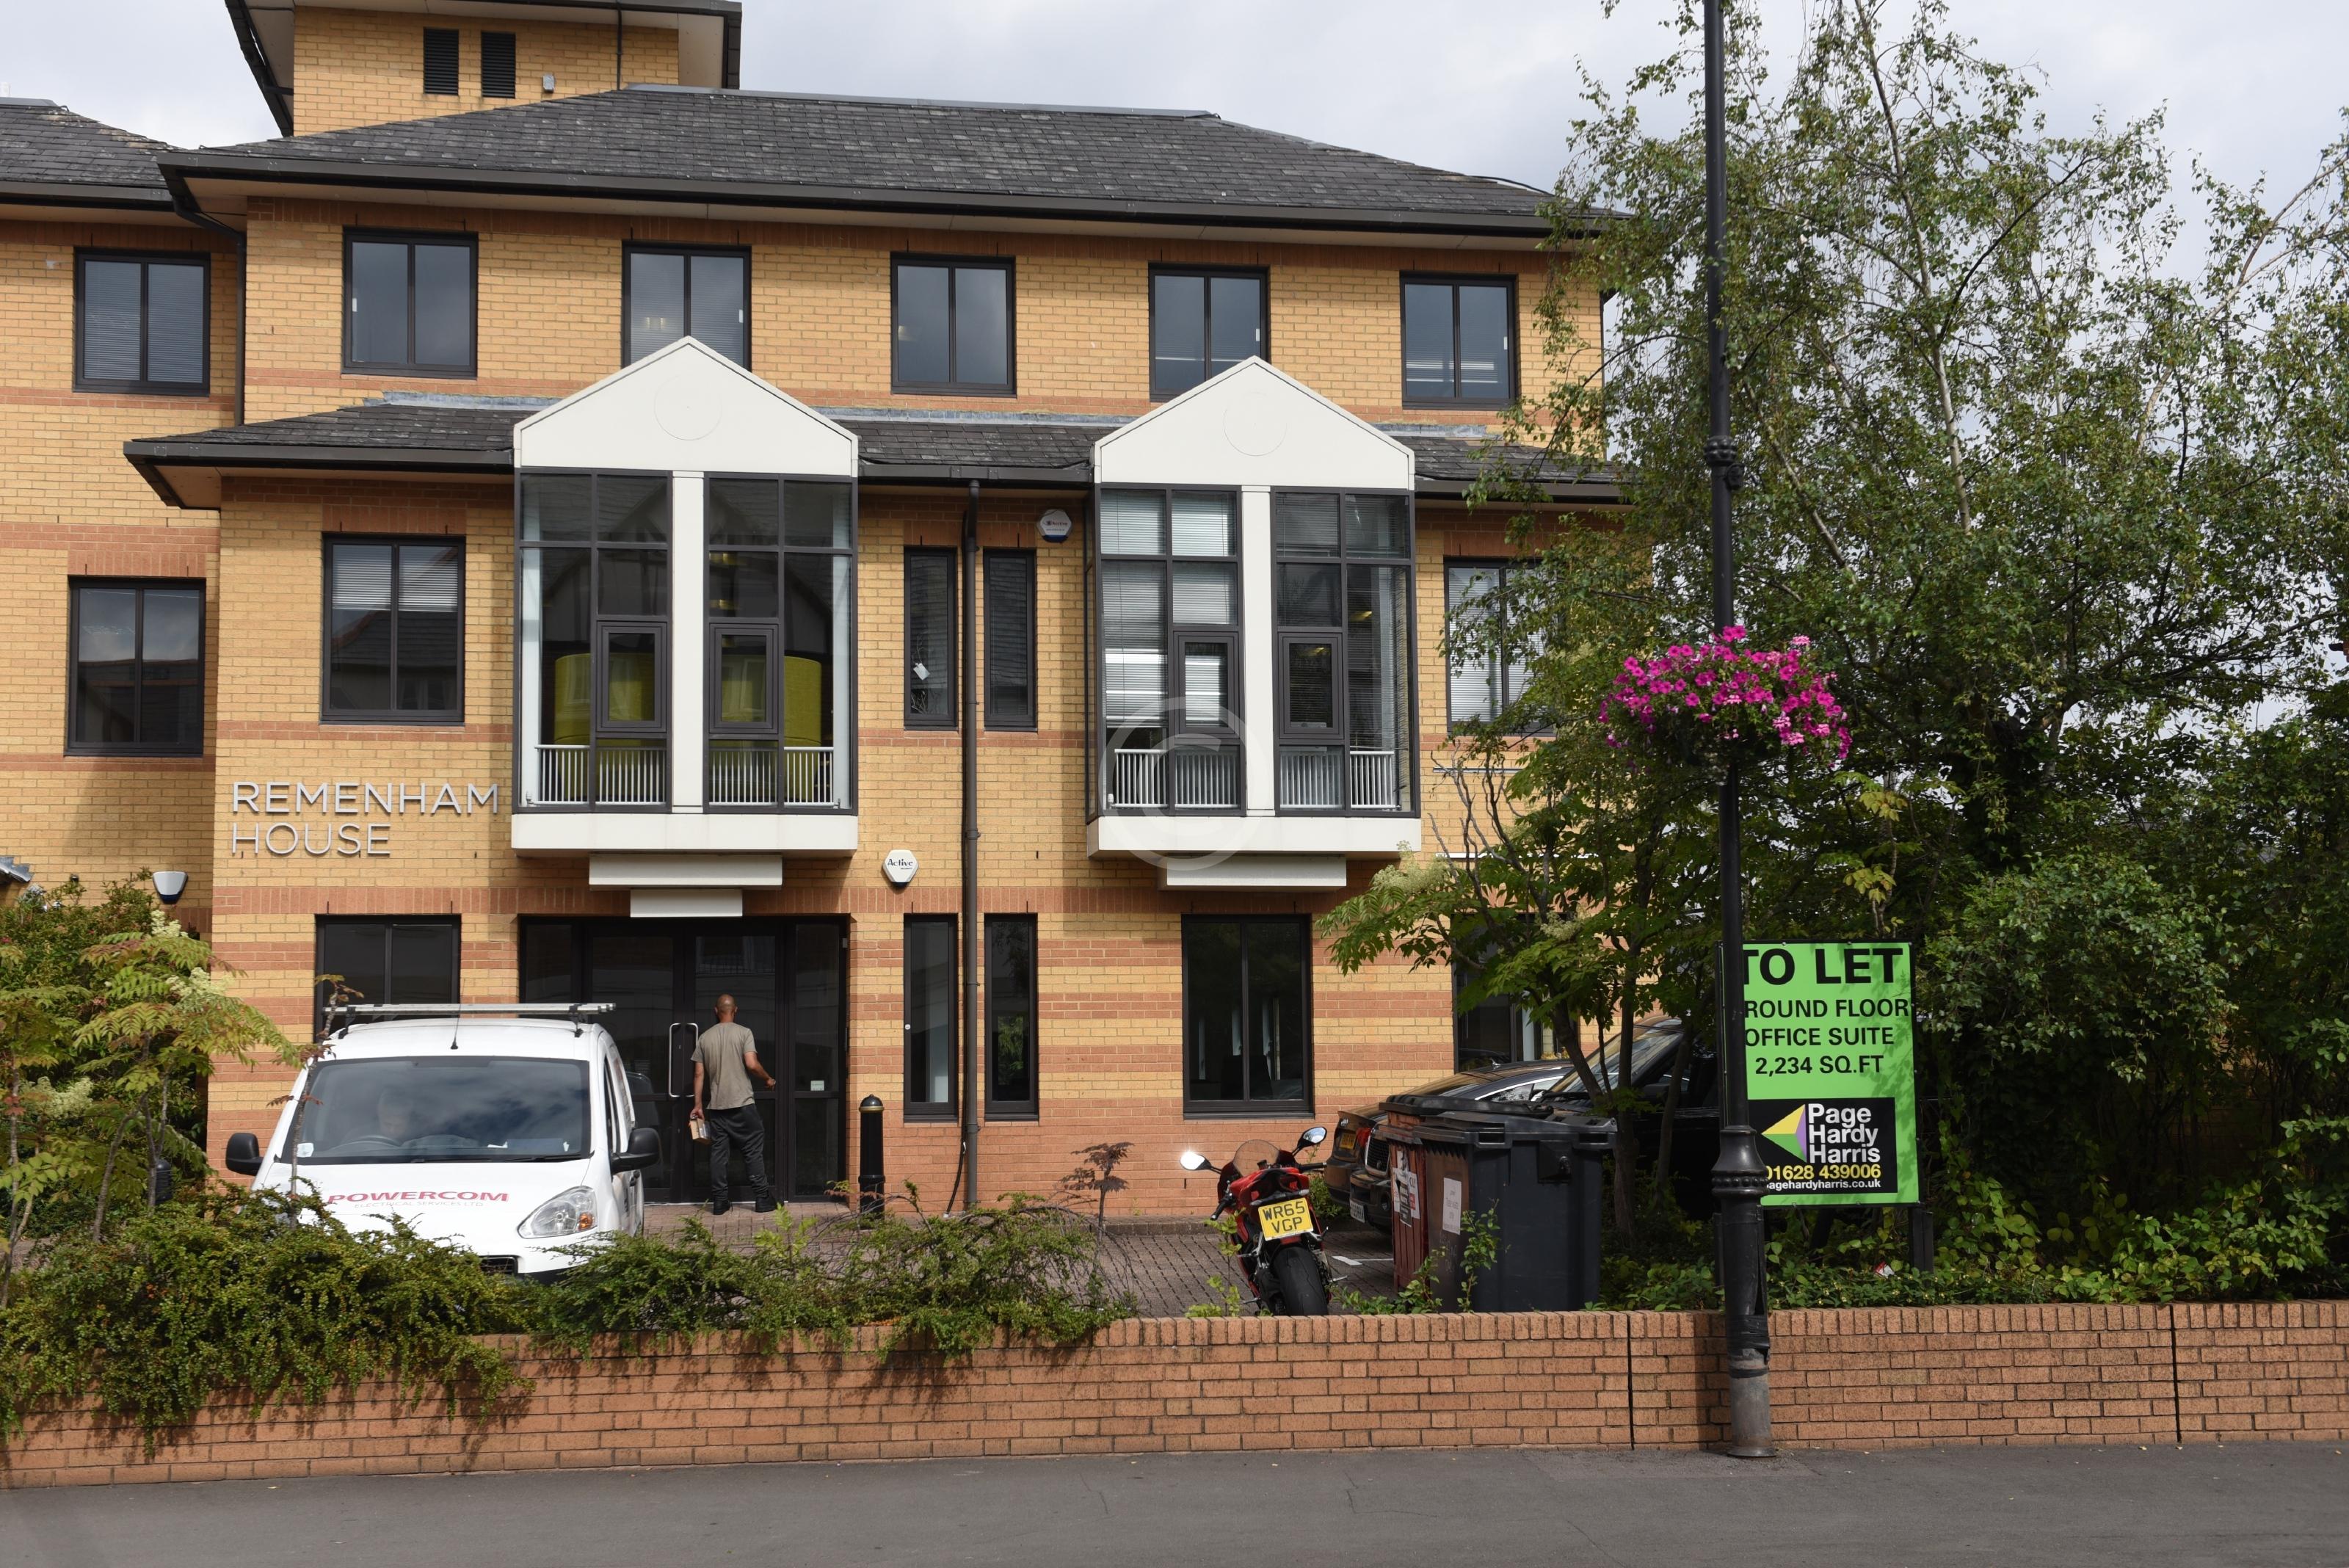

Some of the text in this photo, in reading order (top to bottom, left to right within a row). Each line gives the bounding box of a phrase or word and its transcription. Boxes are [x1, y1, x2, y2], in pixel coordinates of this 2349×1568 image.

[232, 781, 498, 814] REMENHAM
[232, 822, 391, 855] HOUSE
[887, 858, 913, 866] Active
[1815, 948, 1903, 984] LET
[1744, 998, 1909, 1018] ROUND FLOOR
[1745, 1027, 1894, 1046] OFFICE SUITE
[1755, 1056, 1884, 1077] 2,234 SQ.FT
[1808, 1103, 1871, 1128] Page
[1809, 1124, 1878, 1147] Hardy
[1809, 1144, 1881, 1164] Harris
[1818, 1165, 1881, 1179] 439006
[329, 1191, 509, 1204] POWERCOM
[1263, 1201, 1305, 1221] WR65
[1271, 1216, 1302, 1233] VGP
